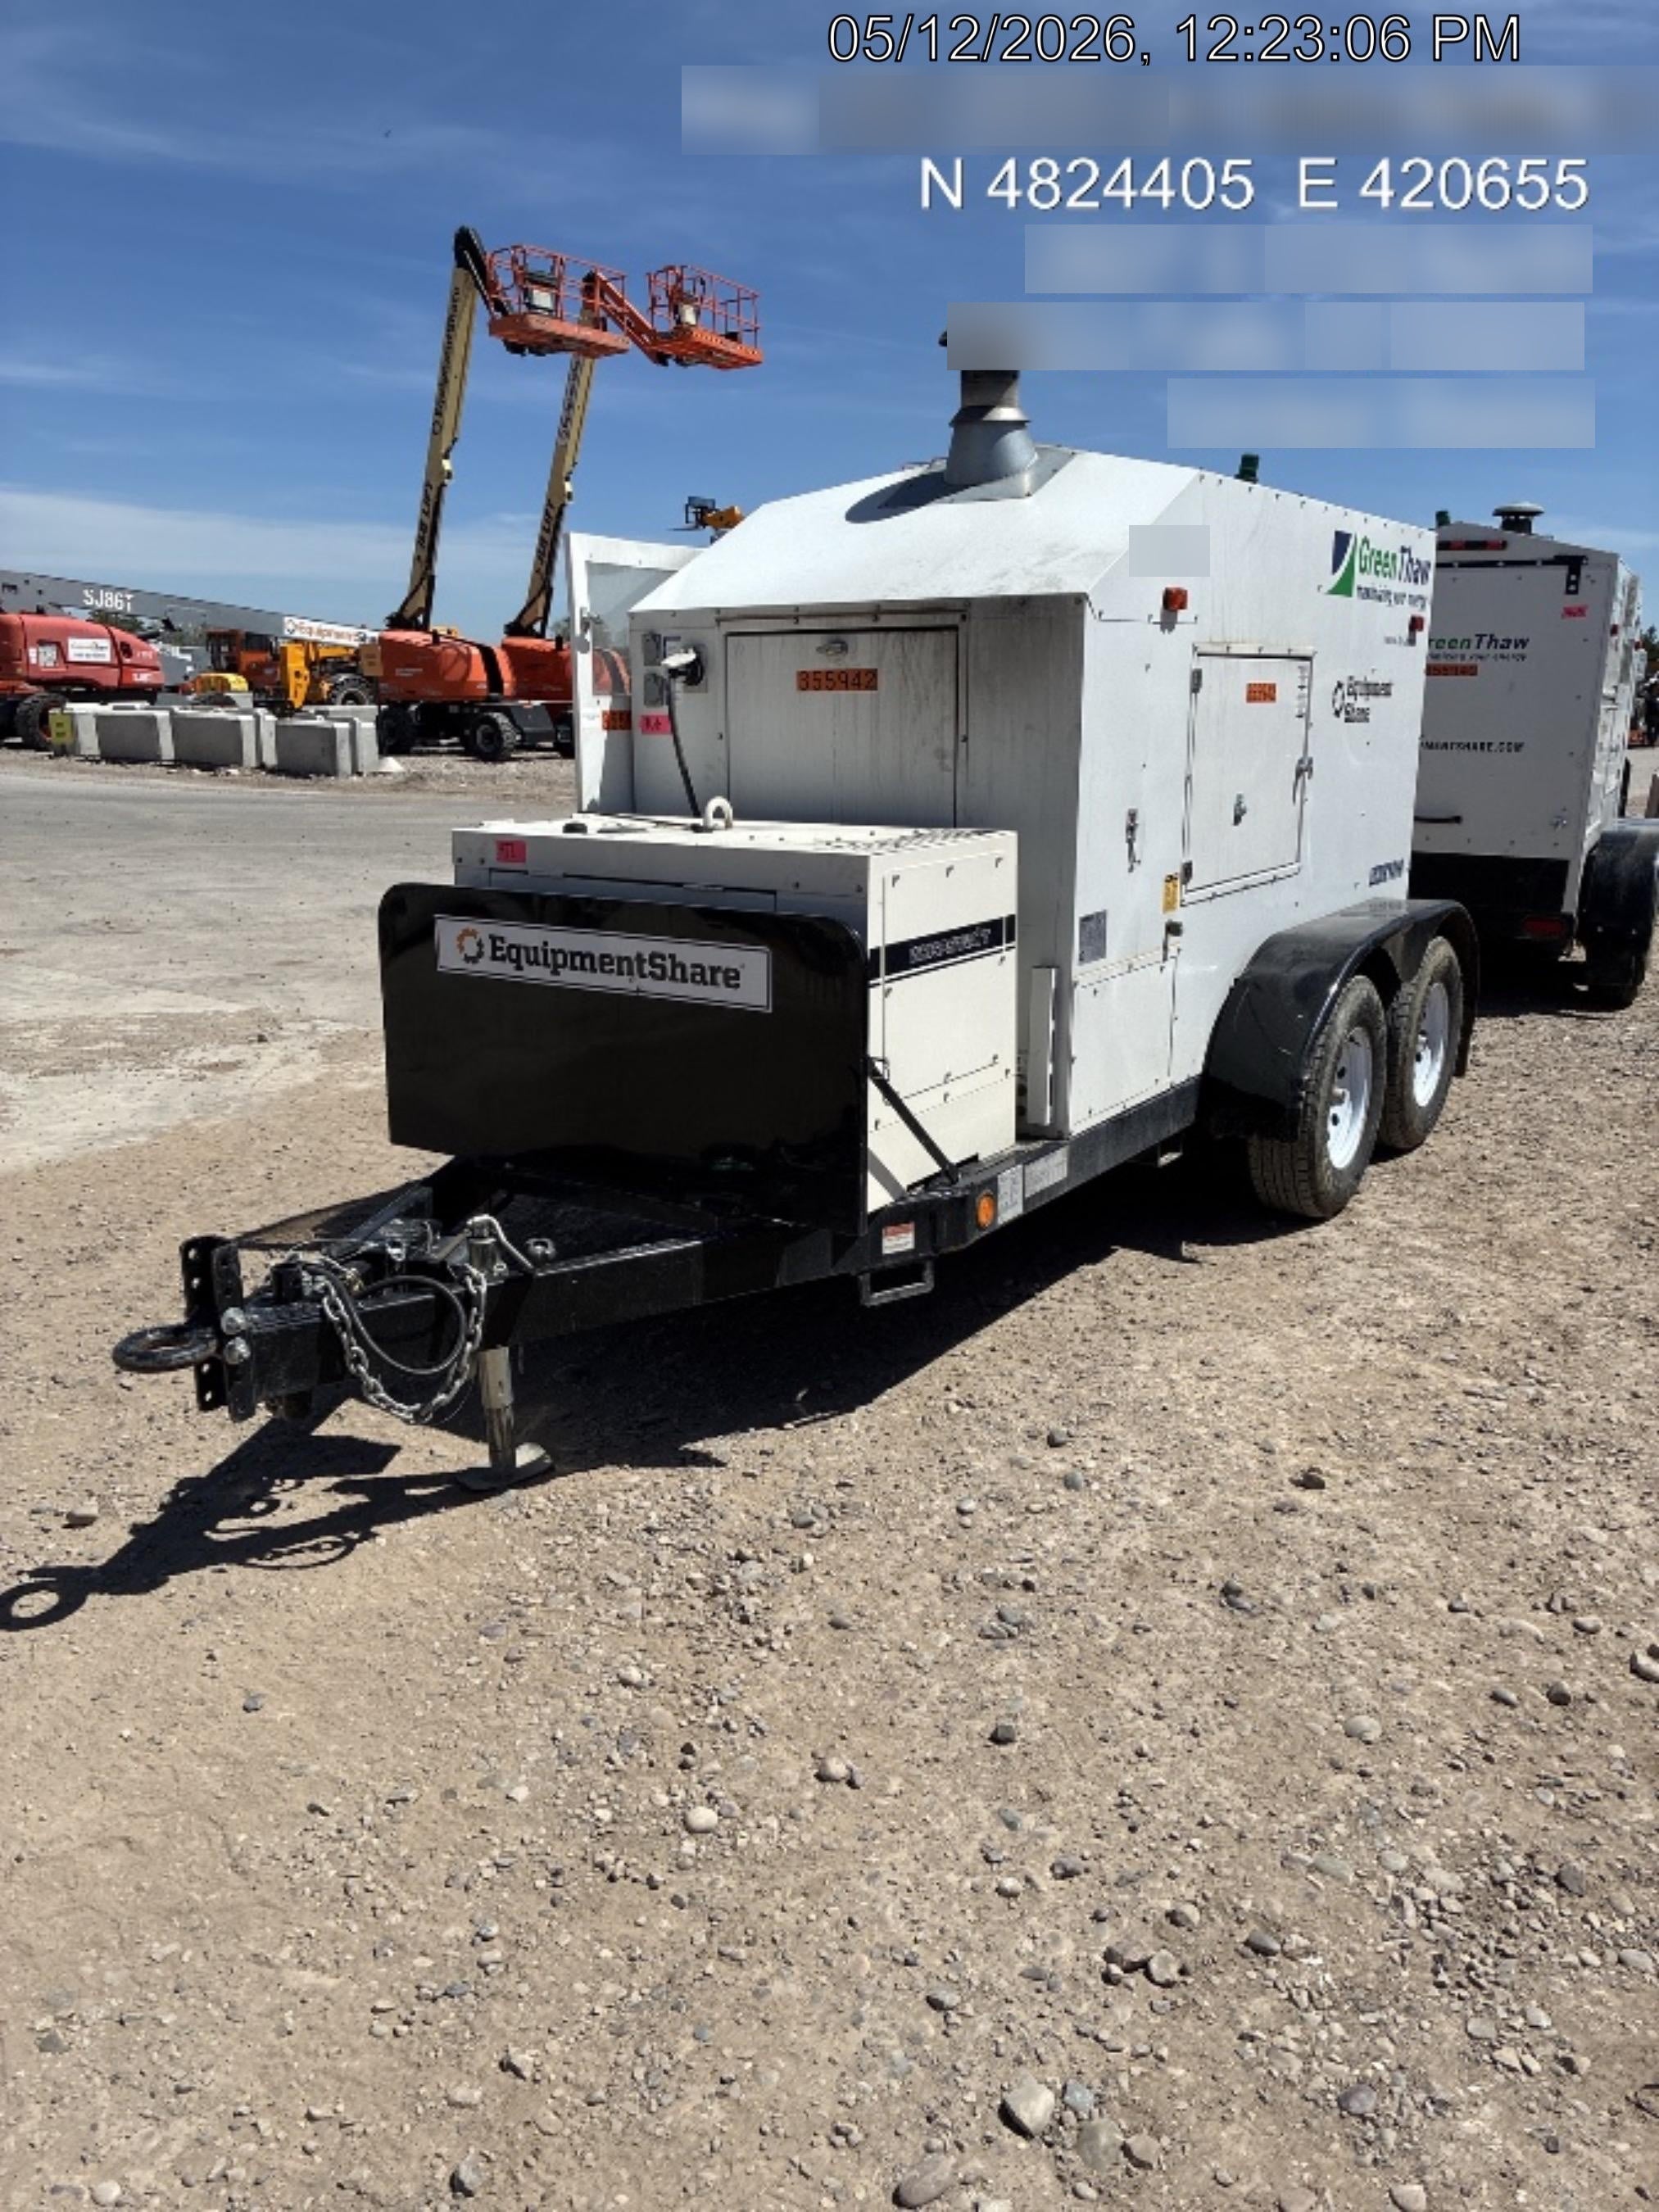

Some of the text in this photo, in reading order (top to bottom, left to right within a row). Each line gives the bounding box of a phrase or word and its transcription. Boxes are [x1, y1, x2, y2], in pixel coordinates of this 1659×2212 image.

[83, 588, 134, 612] SJ86T
[1428, 632, 1530, 650] reenThaw
[798, 669, 878, 691] 355942
[488, 933, 741, 990] EquipmentShare
